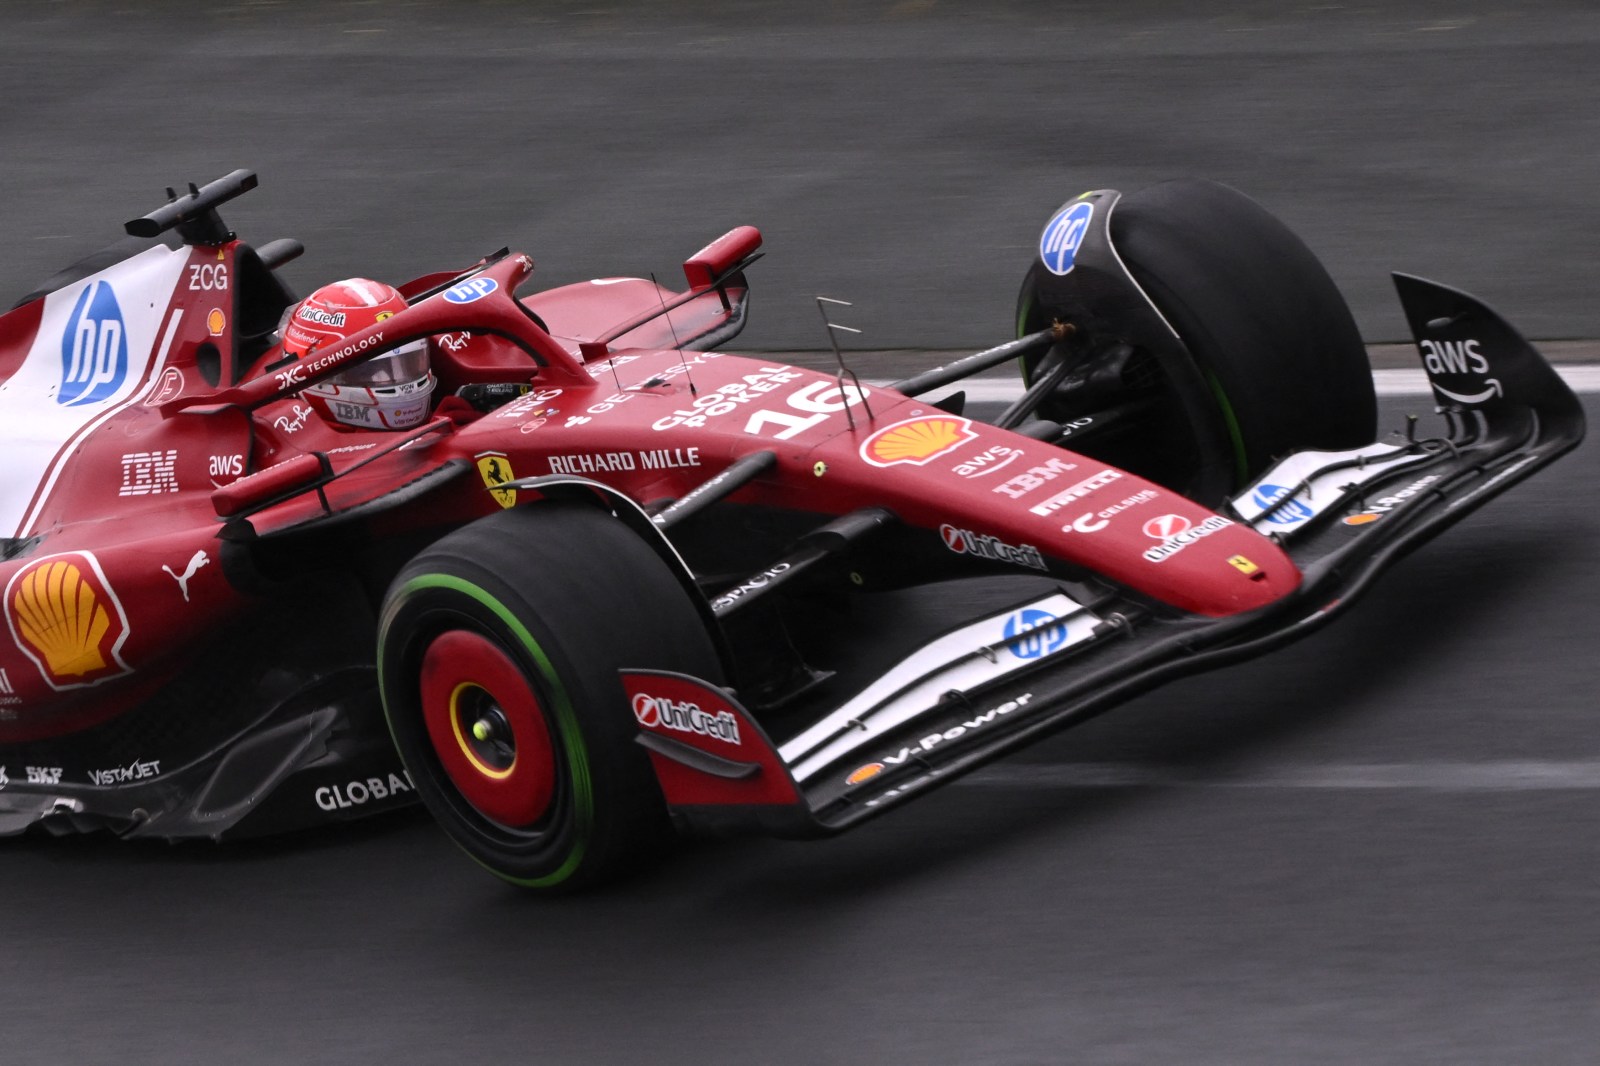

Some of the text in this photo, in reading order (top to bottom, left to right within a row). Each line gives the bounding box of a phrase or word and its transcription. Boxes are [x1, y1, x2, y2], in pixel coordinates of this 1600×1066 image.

[189, 264, 228, 290] ZCG
[448, 279, 488, 300] hp
[300, 306, 345, 328] UniCredit
[62, 281, 123, 406] hp
[307, 331, 384, 373] TECHNOLOGY
[1421, 339, 1489, 374] aws
[336, 403, 370, 421] IBM
[651, 365, 793, 431] GLOBAL
[681, 371, 803, 428] POKER
[744, 380, 872, 440] 16
[119, 449, 179, 496] IBM
[209, 455, 243, 476] aws
[547, 447, 701, 474] RICHARD MILLE
[951, 446, 1012, 477] aws
[993, 458, 1077, 499] IBM
[1098, 490, 1160, 519] CELSIUS
[962, 530, 1049, 571] UniCredit
[1143, 516, 1233, 563] UniCredit
[657, 696, 741, 745] UniCredit
[882, 693, 1033, 763] V-Power
